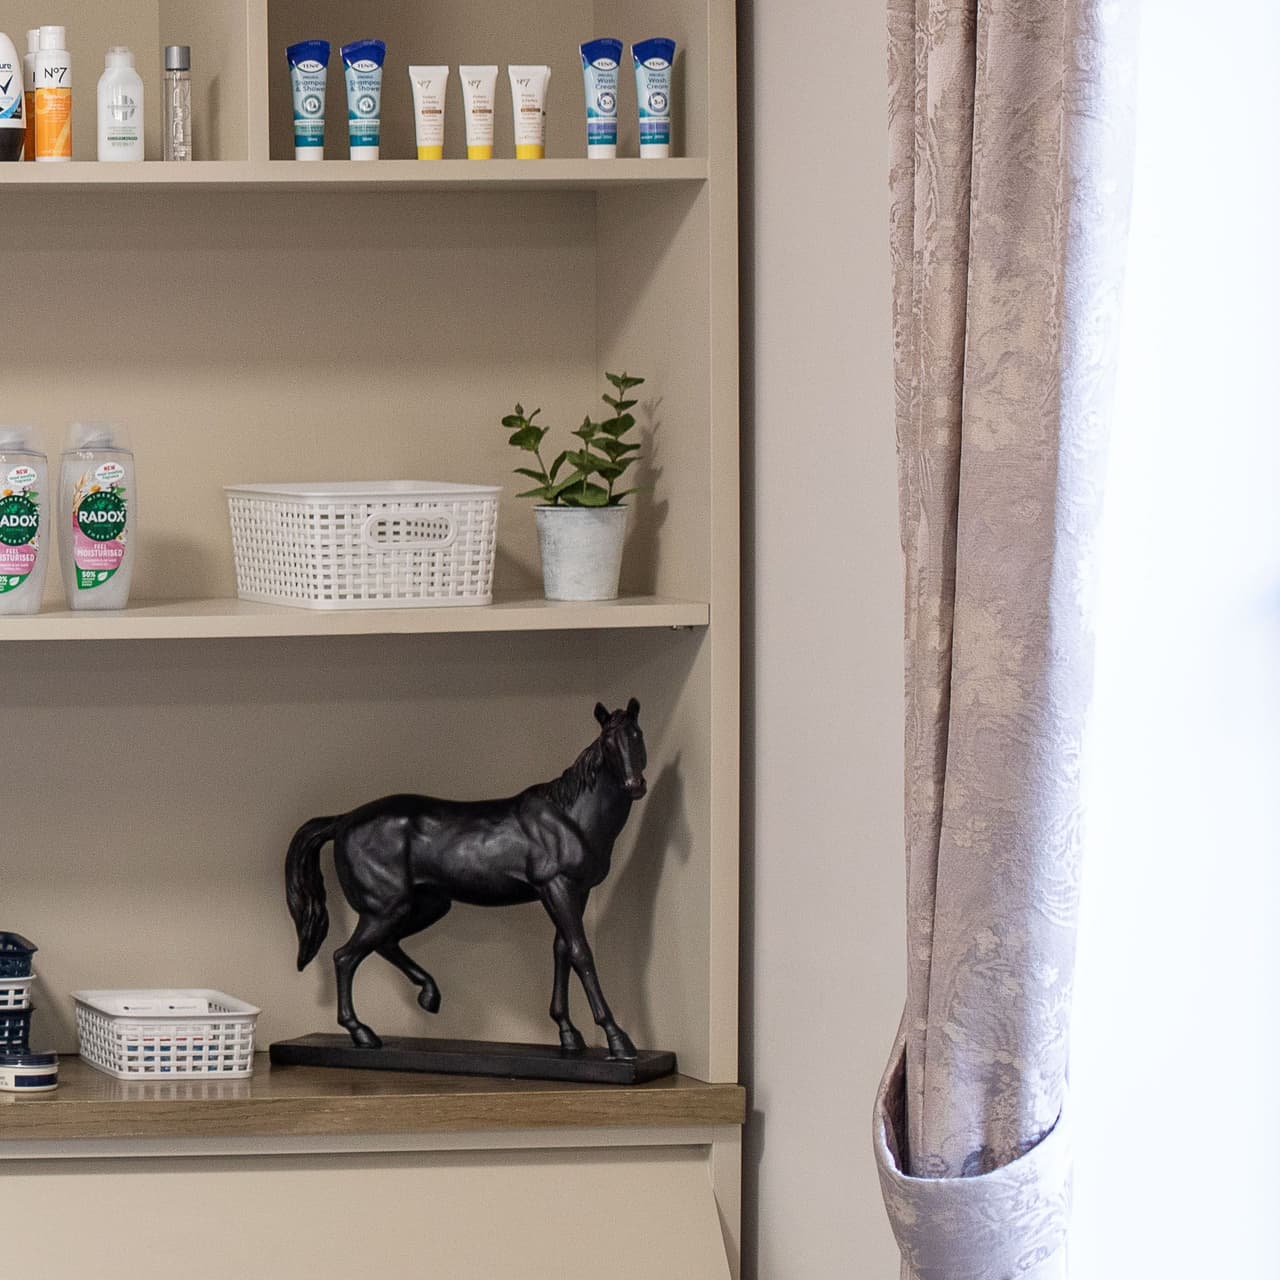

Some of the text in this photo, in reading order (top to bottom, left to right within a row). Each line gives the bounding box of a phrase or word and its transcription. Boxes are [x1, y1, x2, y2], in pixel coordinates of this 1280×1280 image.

[0, 497, 31, 507] MINERAL
[86, 493, 118, 503] MINERAL
[79, 510, 125, 523] RADOX
[77, 549, 123, 557] MOISTURISED
